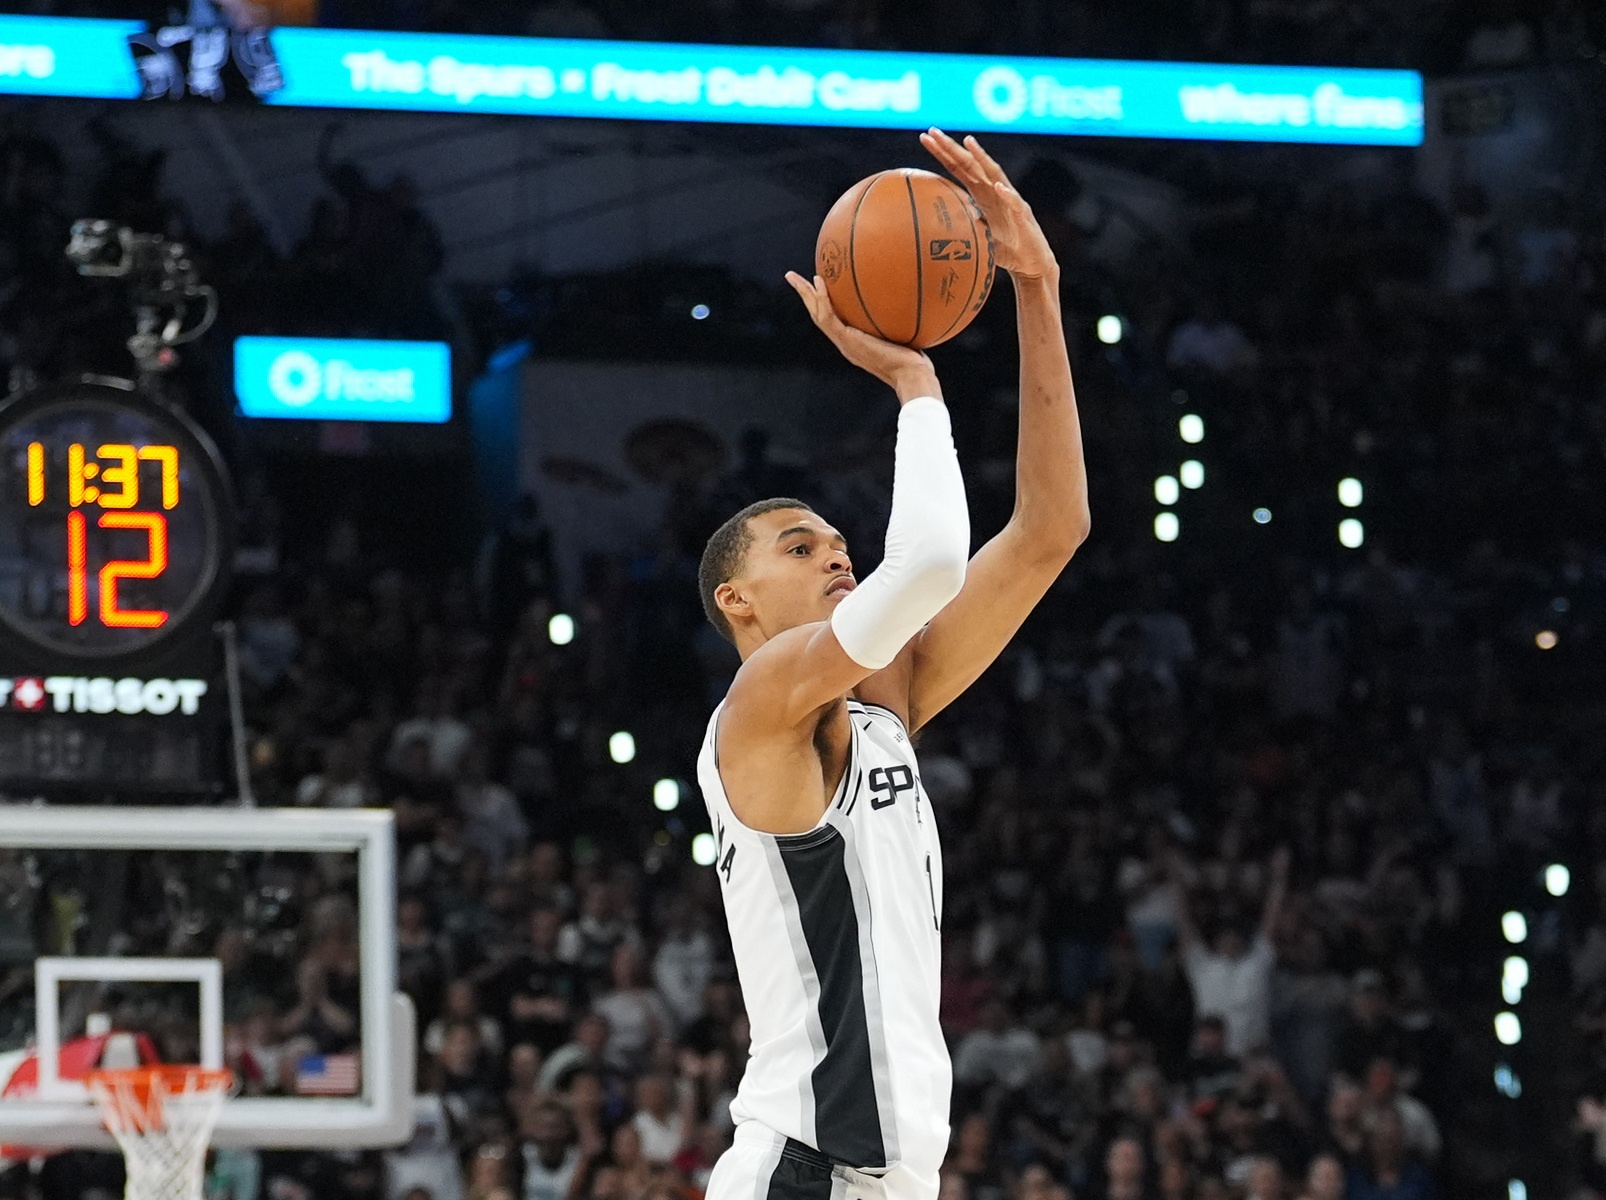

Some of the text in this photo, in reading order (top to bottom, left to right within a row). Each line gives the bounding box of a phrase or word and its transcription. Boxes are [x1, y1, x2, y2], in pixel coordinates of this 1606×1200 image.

[342, 51, 426, 93] The
[427, 56, 556, 104] Spurs
[591, 62, 701, 105] Frost
[818, 71, 921, 113] Card
[1029, 75, 1123, 119] Frost
[325, 359, 416, 403] Frost
[28, 442, 179, 510] 11:37
[67, 511, 169, 628] 12
[44, 677, 208, 715] TISSOT
